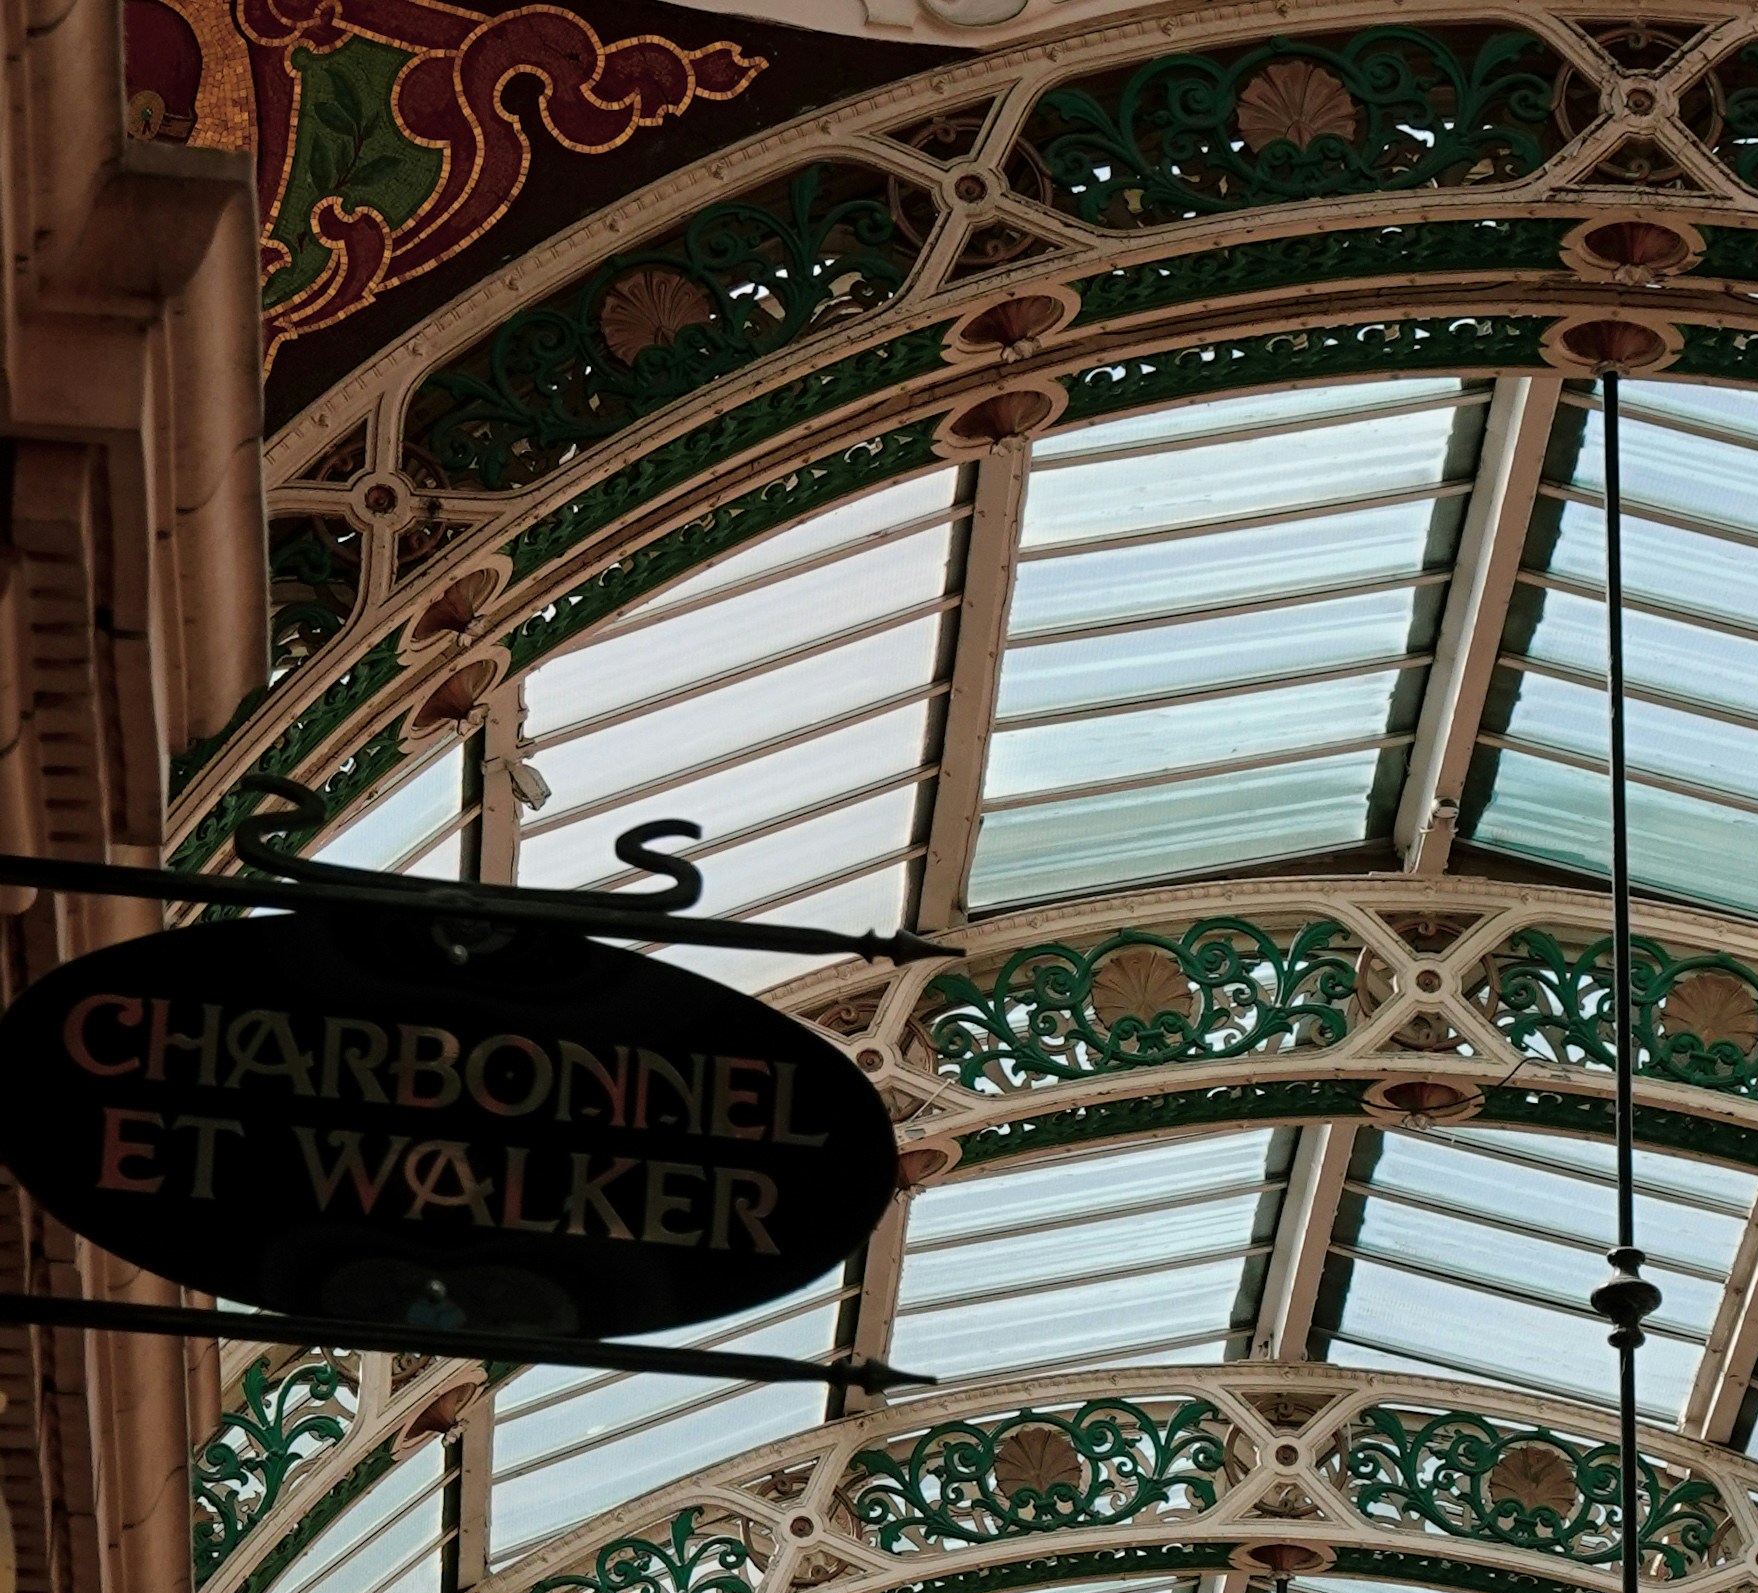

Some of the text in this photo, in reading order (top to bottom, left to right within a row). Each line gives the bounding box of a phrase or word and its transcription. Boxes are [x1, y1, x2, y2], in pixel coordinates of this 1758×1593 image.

[63, 994, 829, 1148] CHARBONNEL
[96, 1107, 782, 1256] ET WALKER
